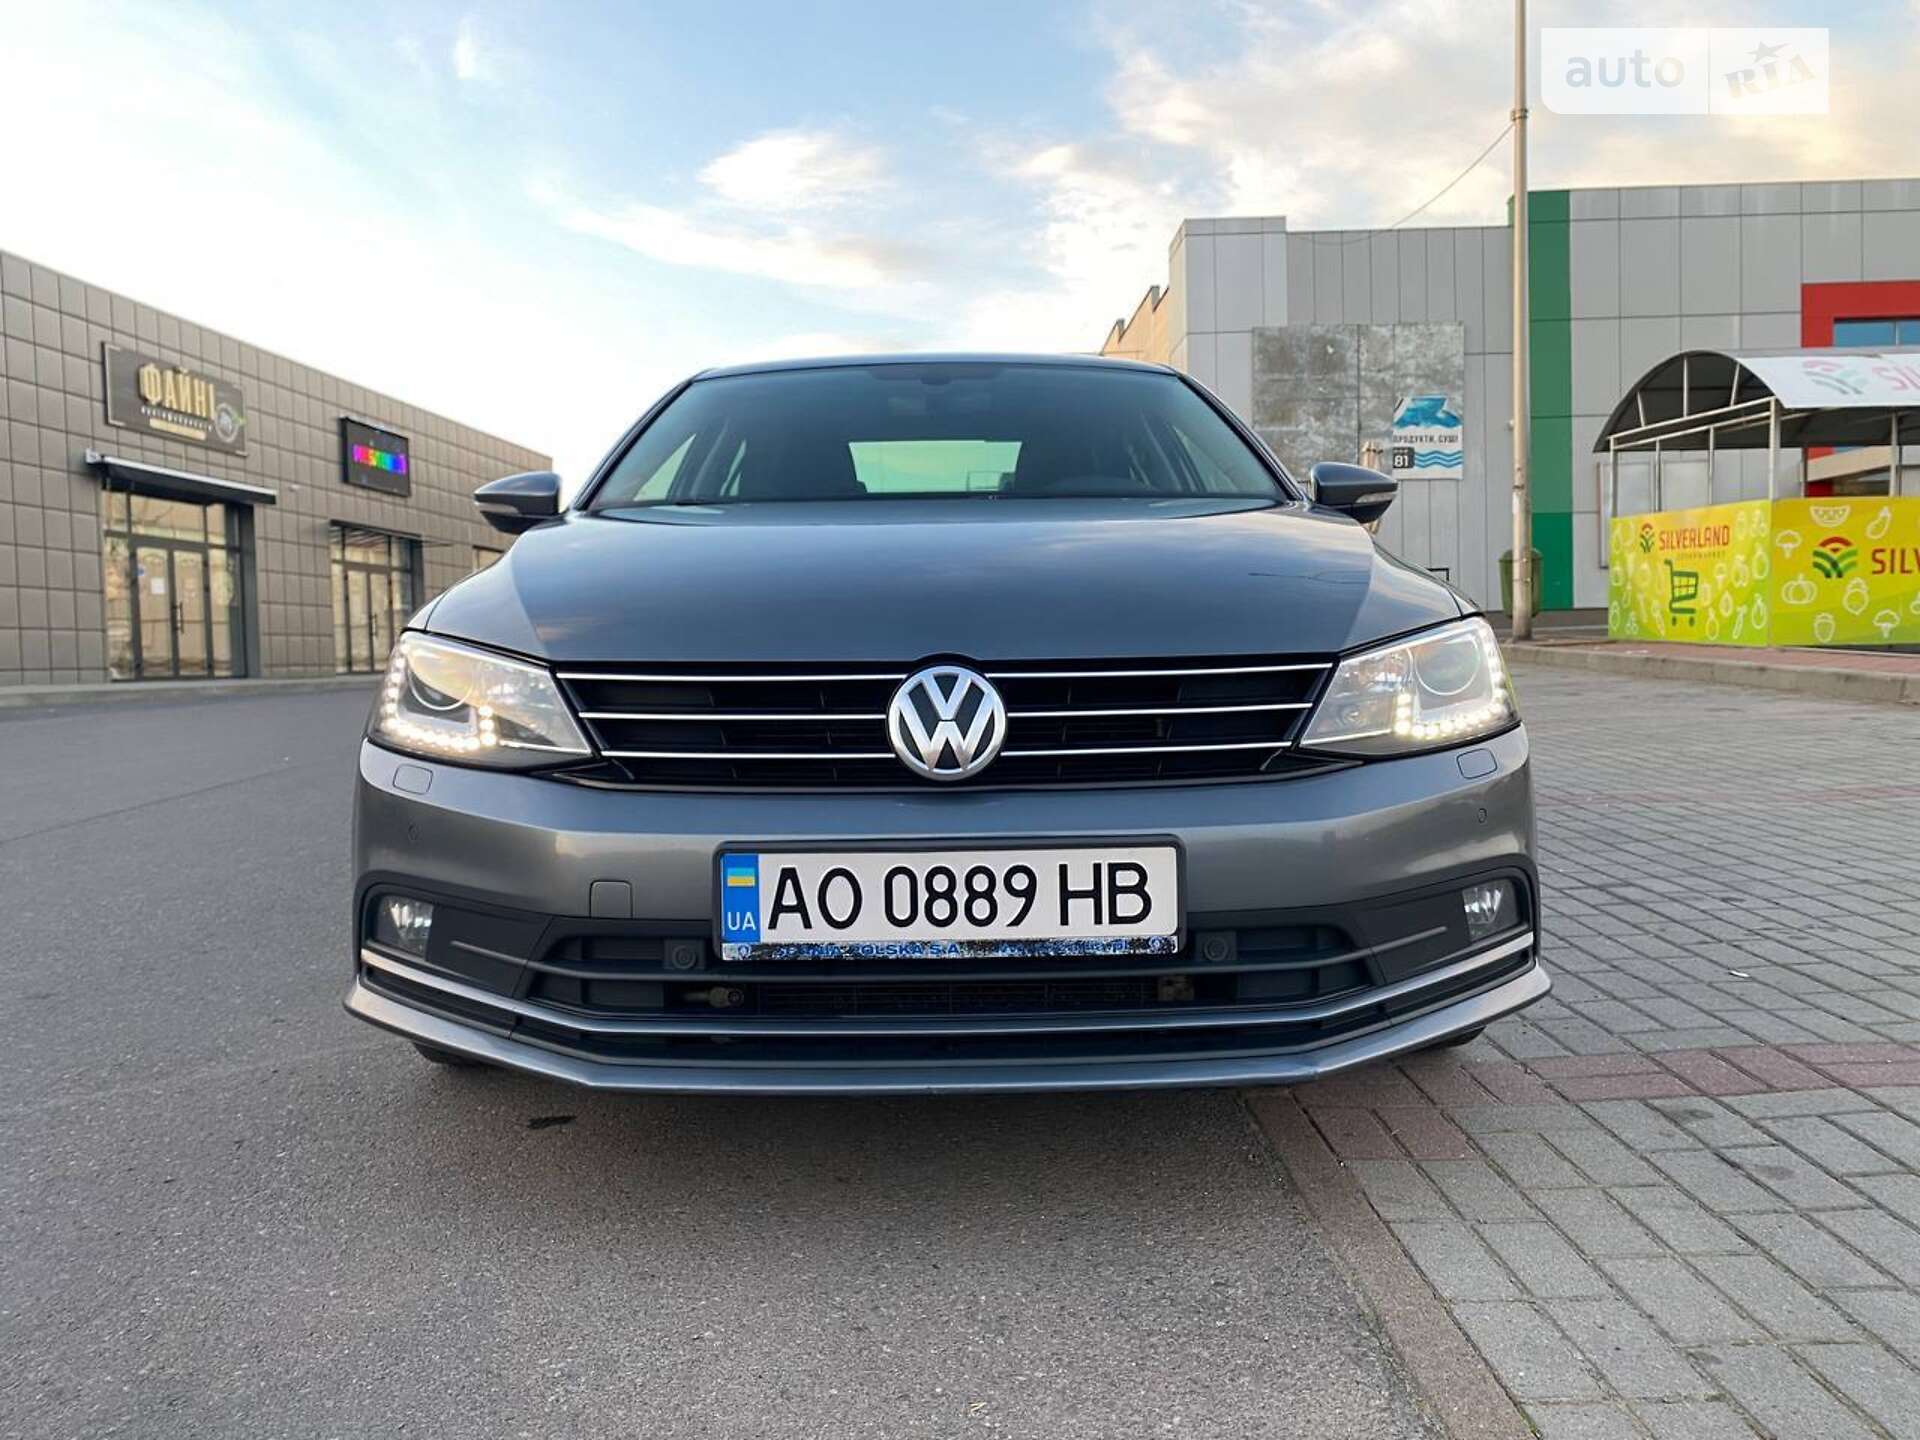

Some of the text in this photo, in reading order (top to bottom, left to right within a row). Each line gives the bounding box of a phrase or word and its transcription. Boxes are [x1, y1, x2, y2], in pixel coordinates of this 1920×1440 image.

[142, 362, 216, 421] ФАЙНІ
[1394, 455, 1409, 468] 81
[1658, 524, 1731, 551] SILVERLAND
[768, 862, 1153, 930] AO 0889 HB
[727, 910, 757, 932] UA
